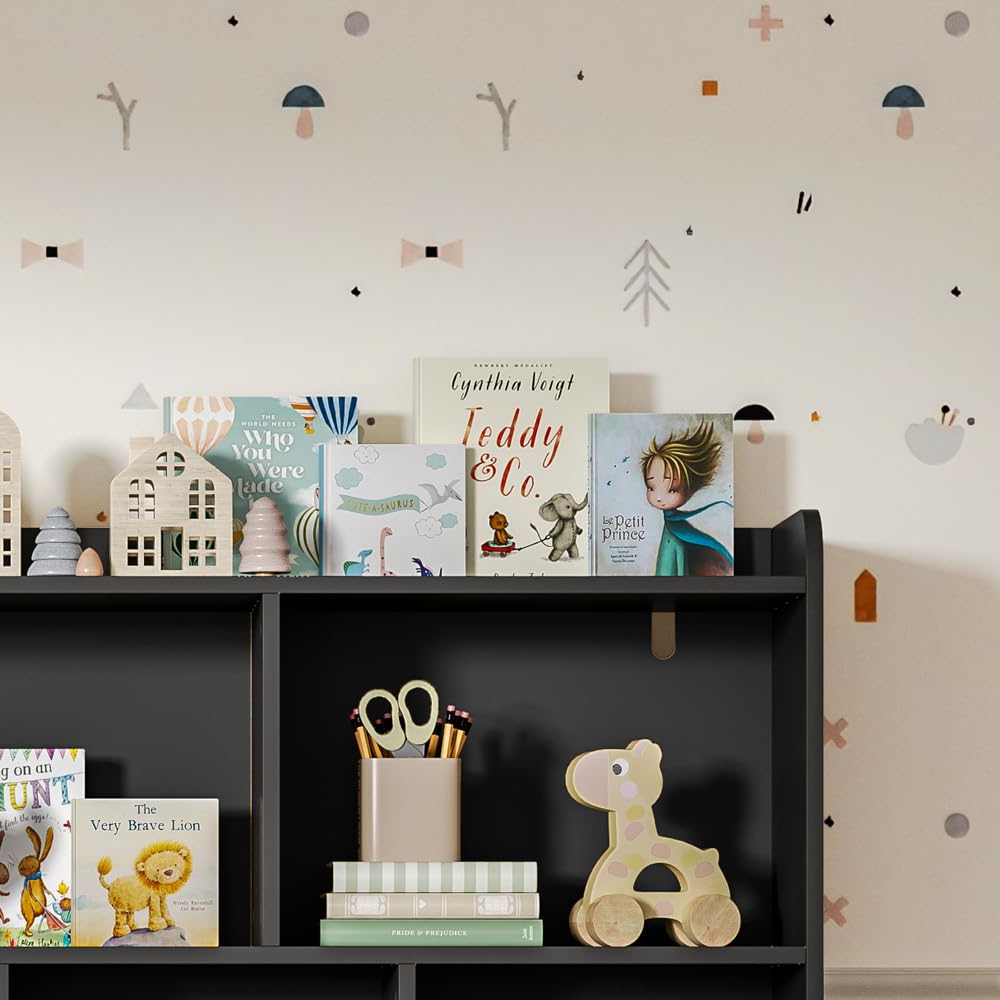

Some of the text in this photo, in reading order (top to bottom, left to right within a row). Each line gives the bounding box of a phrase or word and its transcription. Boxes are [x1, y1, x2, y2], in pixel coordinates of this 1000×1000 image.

[451, 371, 575, 401] Cynthia Voigt
[243, 429, 295, 452] Who
[462, 406, 564, 469] Teddy
[232, 444, 272, 460] You
[248, 462, 305, 479] Were
[470, 453, 540, 498] & Co.
[602, 514, 645, 530] Le Petit
[601, 527, 646, 543] Prince
[14, 765, 32, 776] on
[36, 763, 53, 774] an
[134, 803, 157, 815] The
[90, 819, 201, 836] Very Brave Lion
